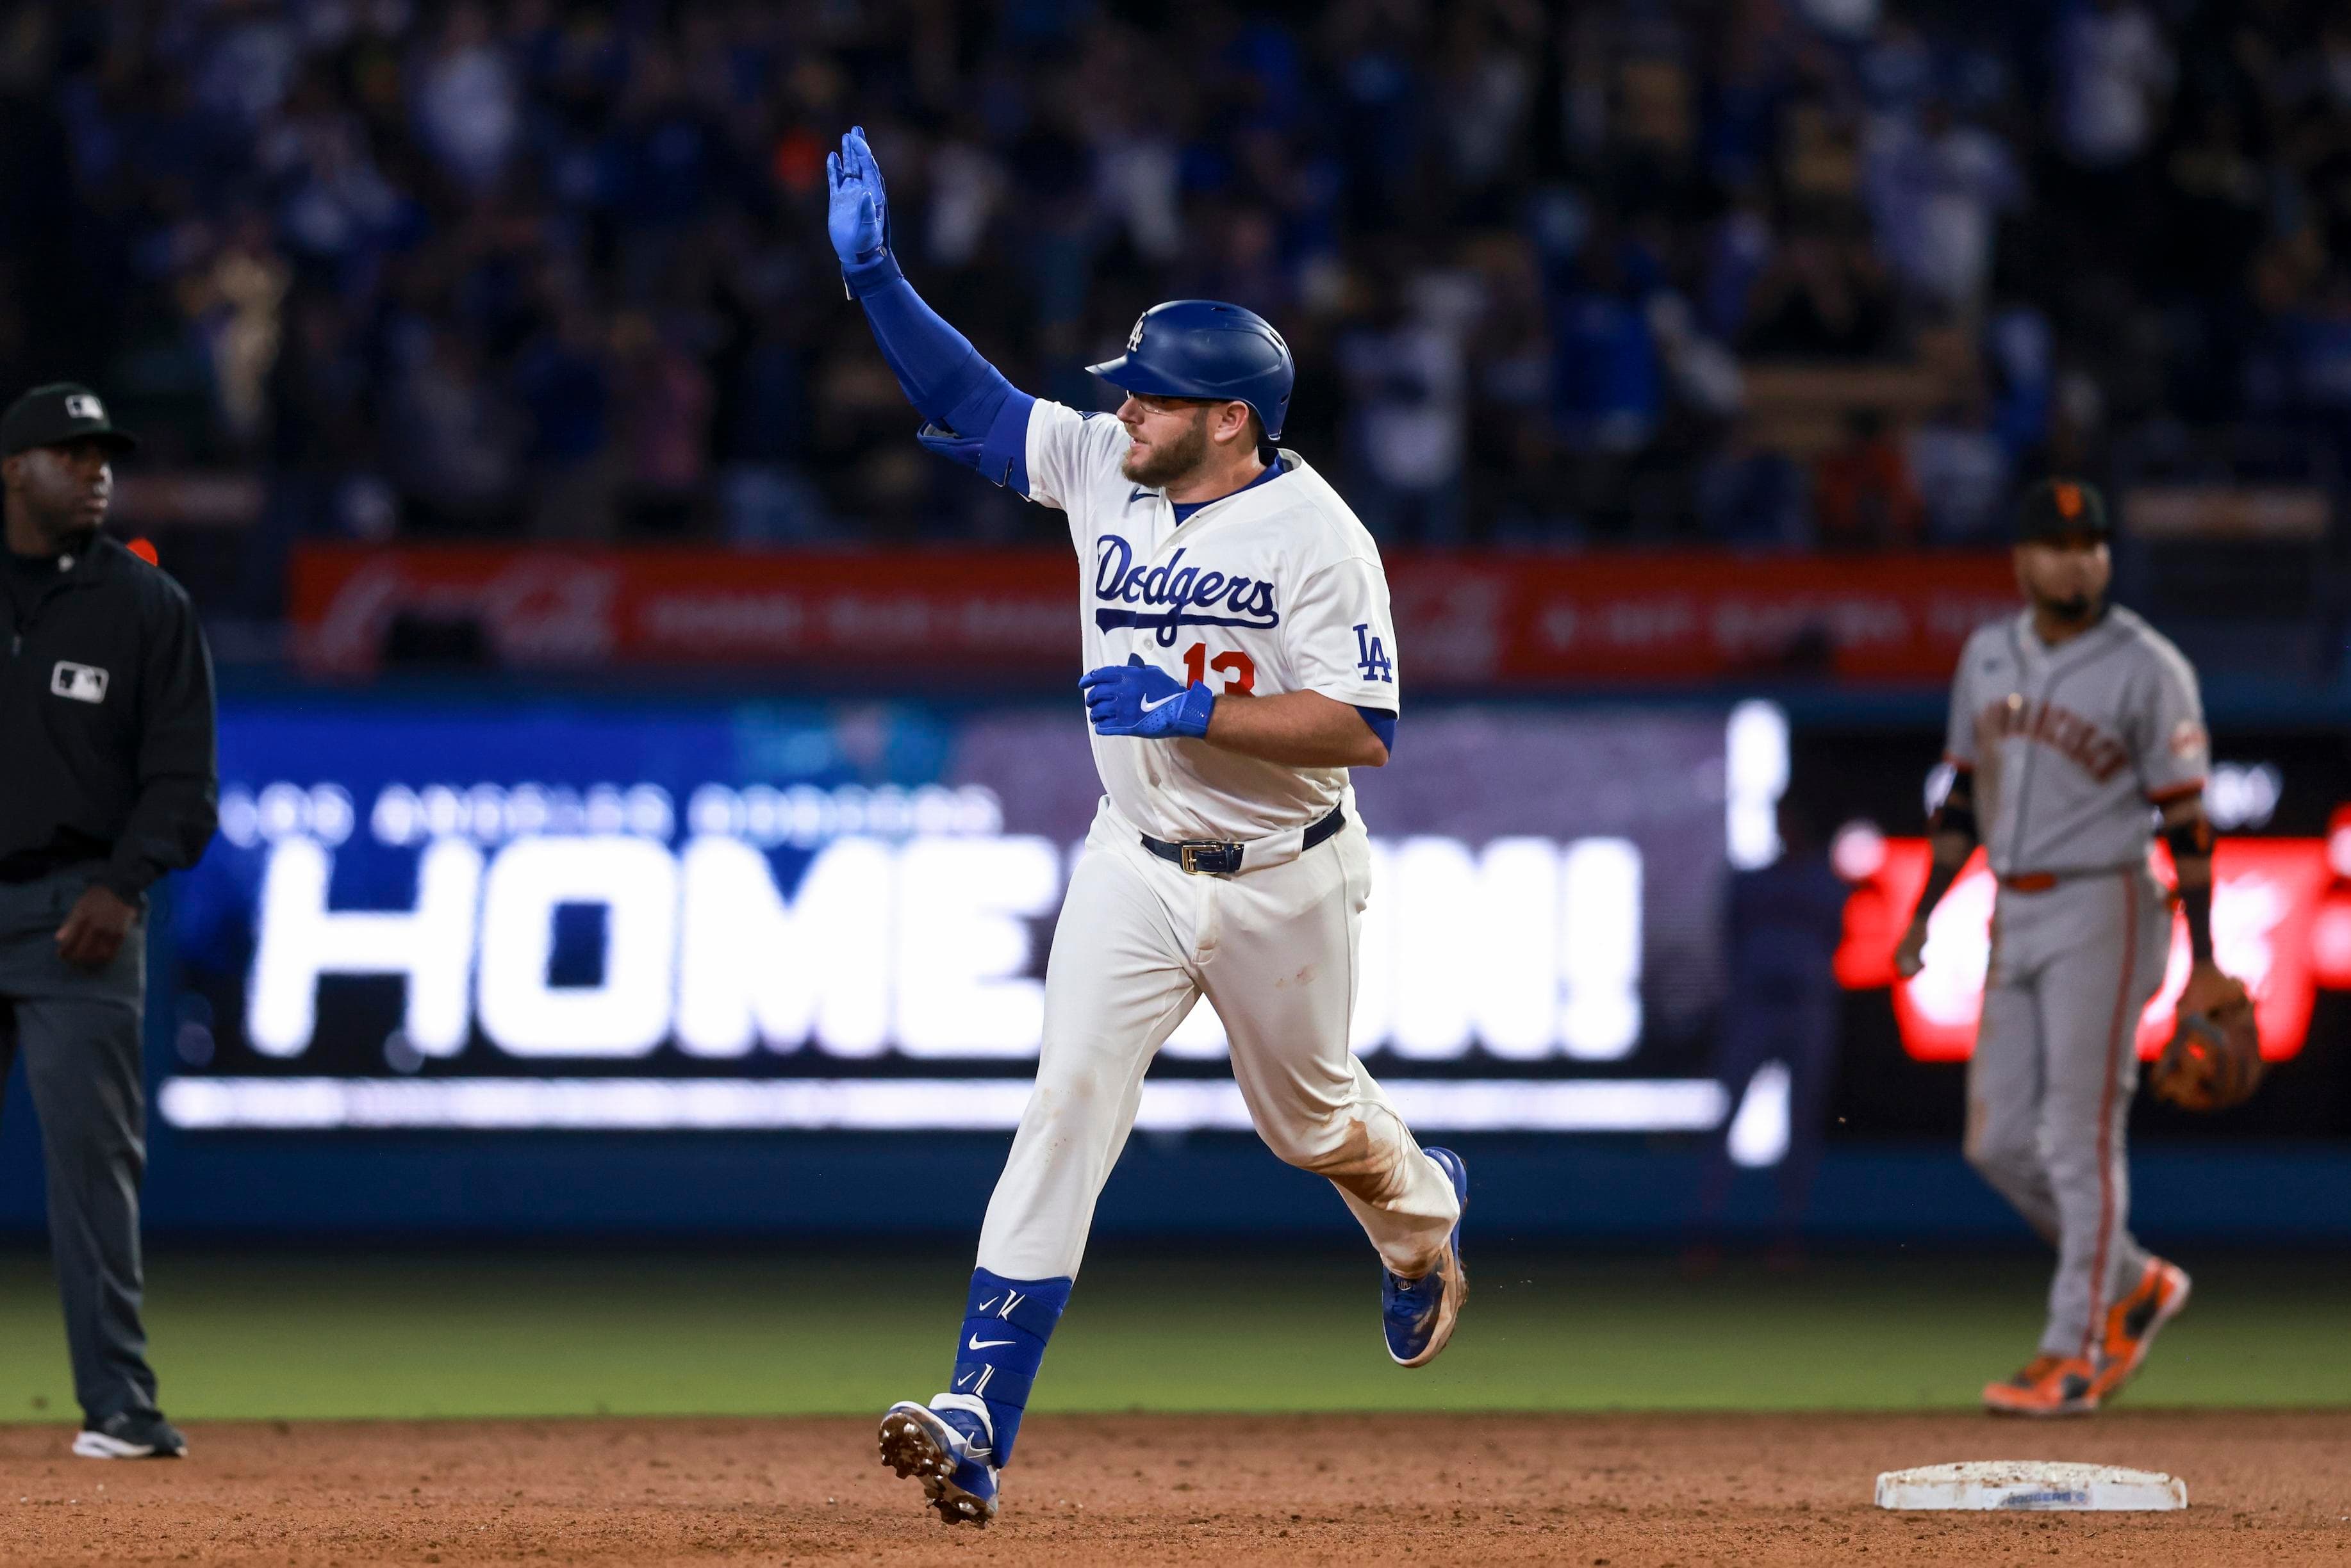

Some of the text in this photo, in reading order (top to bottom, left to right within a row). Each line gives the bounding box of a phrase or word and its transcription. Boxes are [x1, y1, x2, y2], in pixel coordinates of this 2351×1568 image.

[1126, 311, 1146, 352] LA
[1096, 534, 1279, 647] Dodgers
[1184, 642, 1256, 697] 13
[1353, 623, 1392, 683] LA
[246, 835, 1060, 1059] HOME
